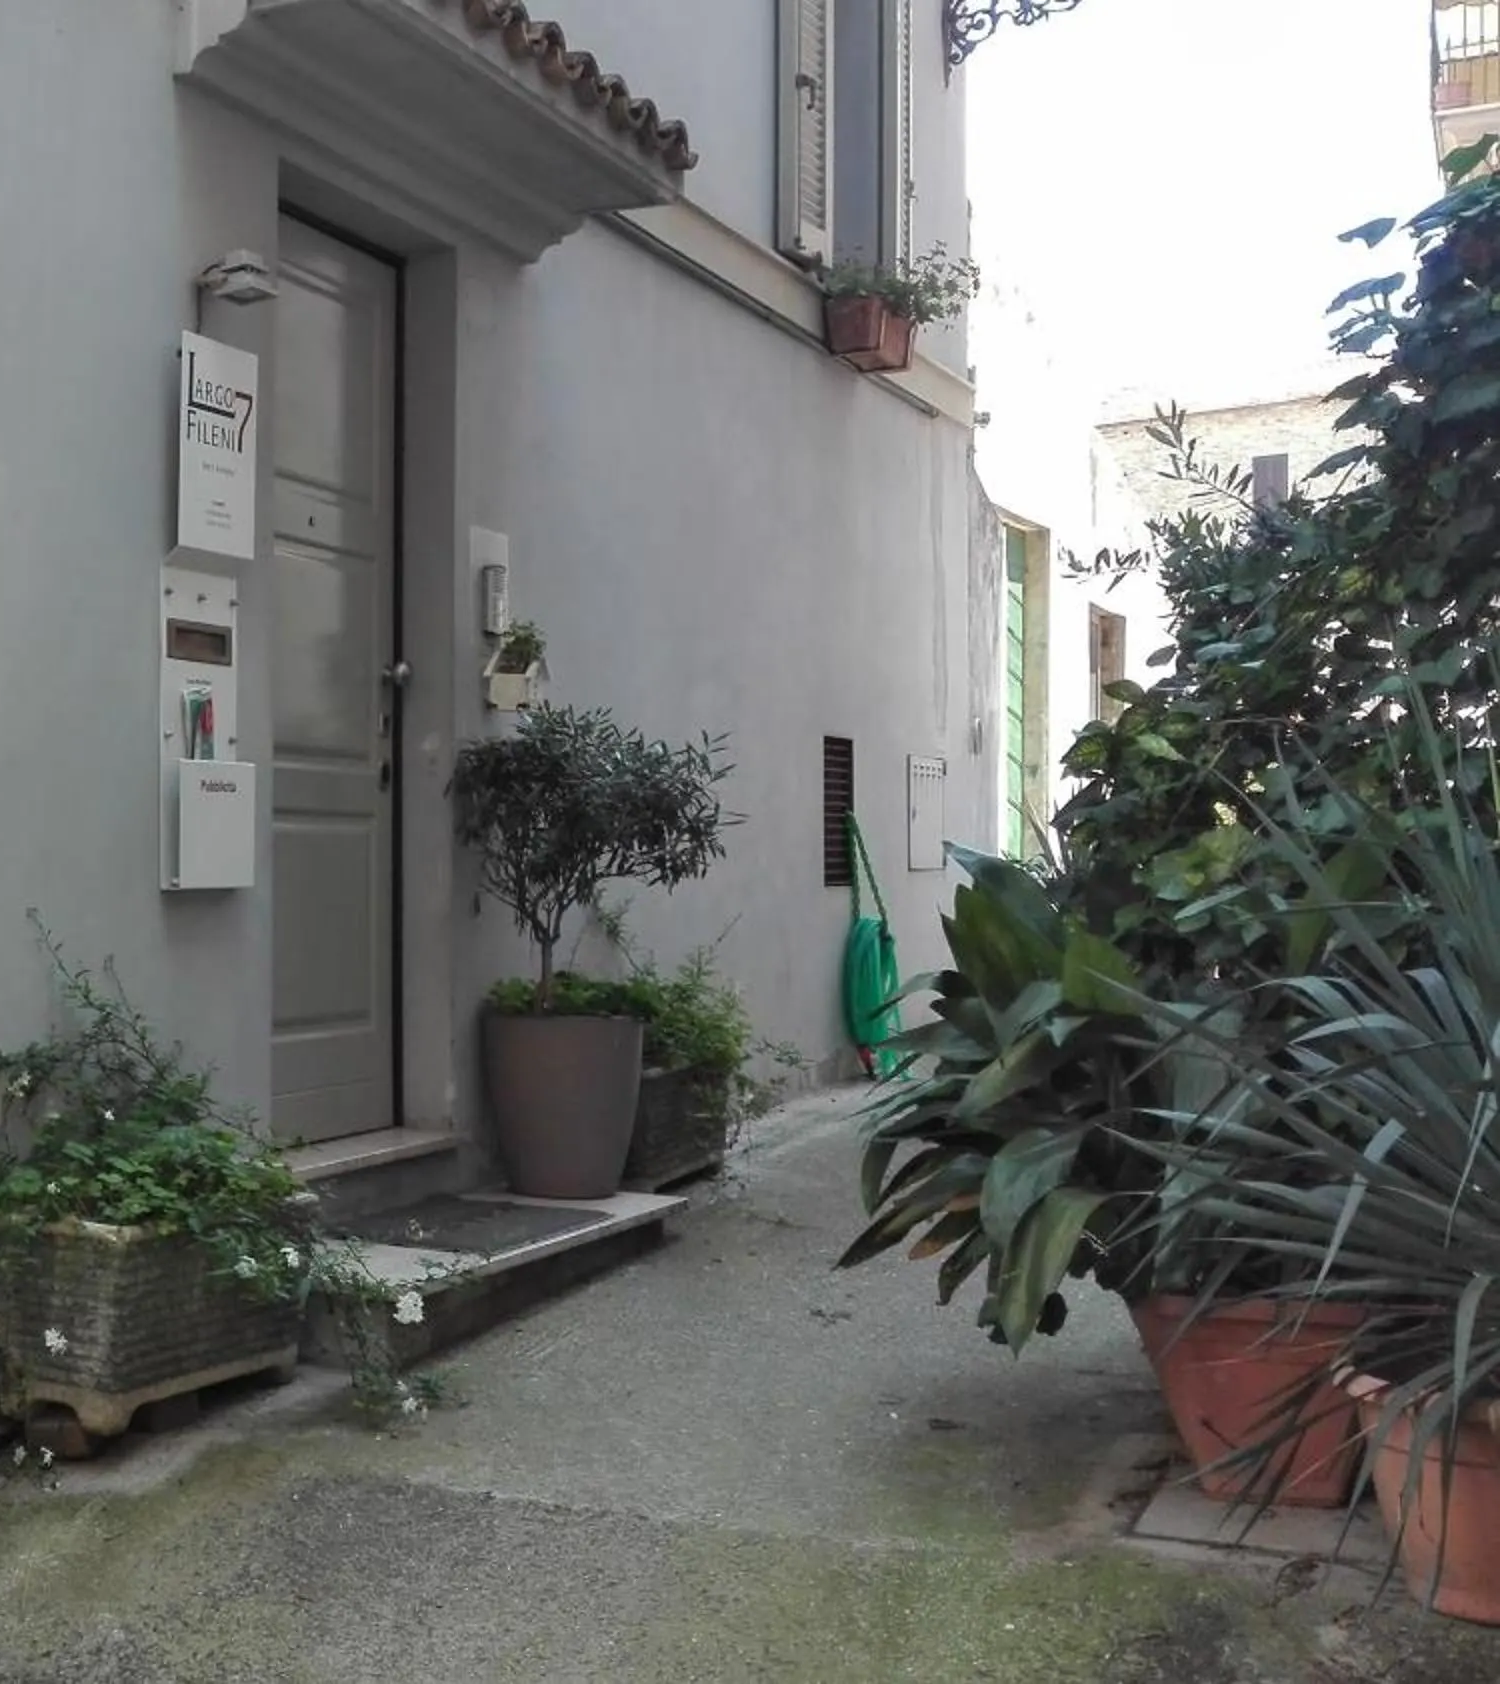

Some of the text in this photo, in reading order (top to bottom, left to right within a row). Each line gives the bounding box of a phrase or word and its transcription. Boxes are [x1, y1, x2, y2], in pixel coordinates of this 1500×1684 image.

[188, 351, 235, 418] LARGO
[186, 391, 253, 453] FILENI 7
